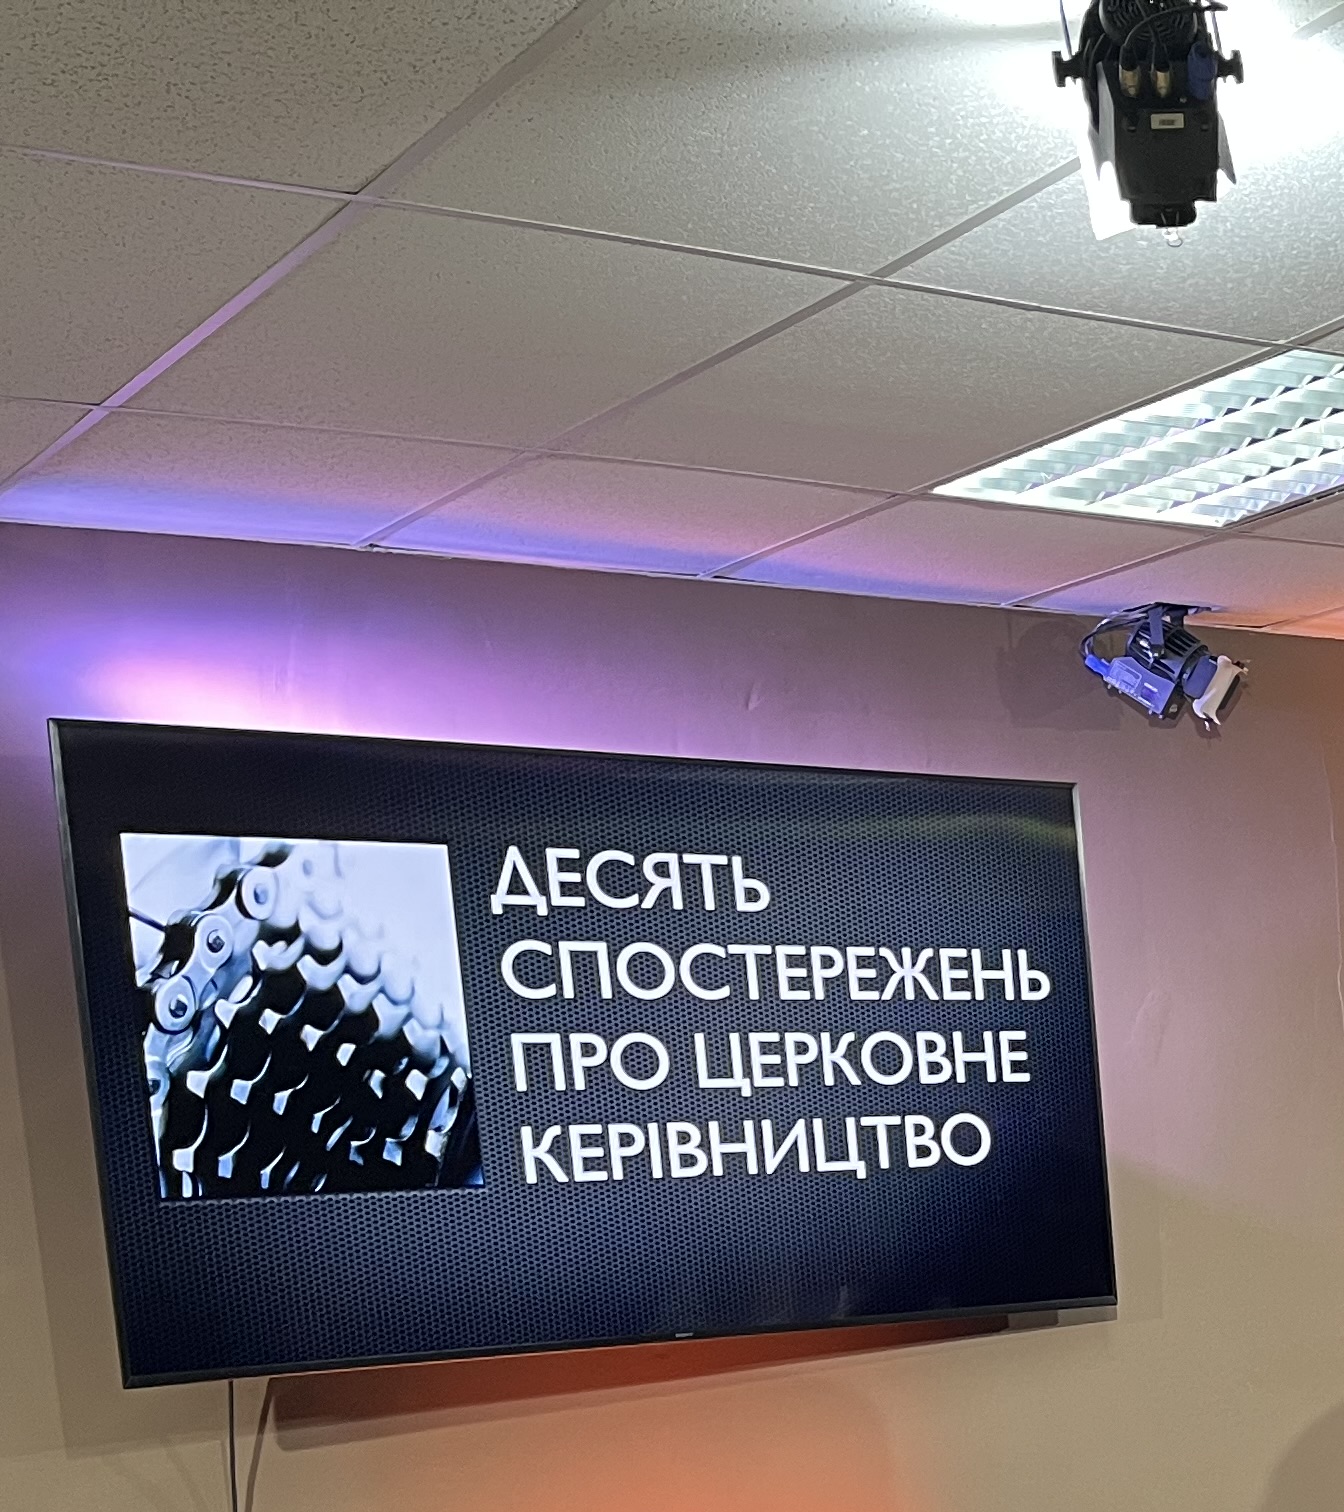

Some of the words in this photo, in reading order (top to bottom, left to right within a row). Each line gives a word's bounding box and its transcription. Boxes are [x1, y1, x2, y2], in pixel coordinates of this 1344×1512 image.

[490, 845, 771, 917] ДЕСЯТЬ
[500, 939, 1051, 1001] СПОСТЕРЕЖЕНЬ
[510, 1032, 671, 1092] ПРО
[693, 1030, 1031, 1098] ЦЕРКОВНЕ
[520, 1112, 992, 1185] КЕРІВНИЦТВО
